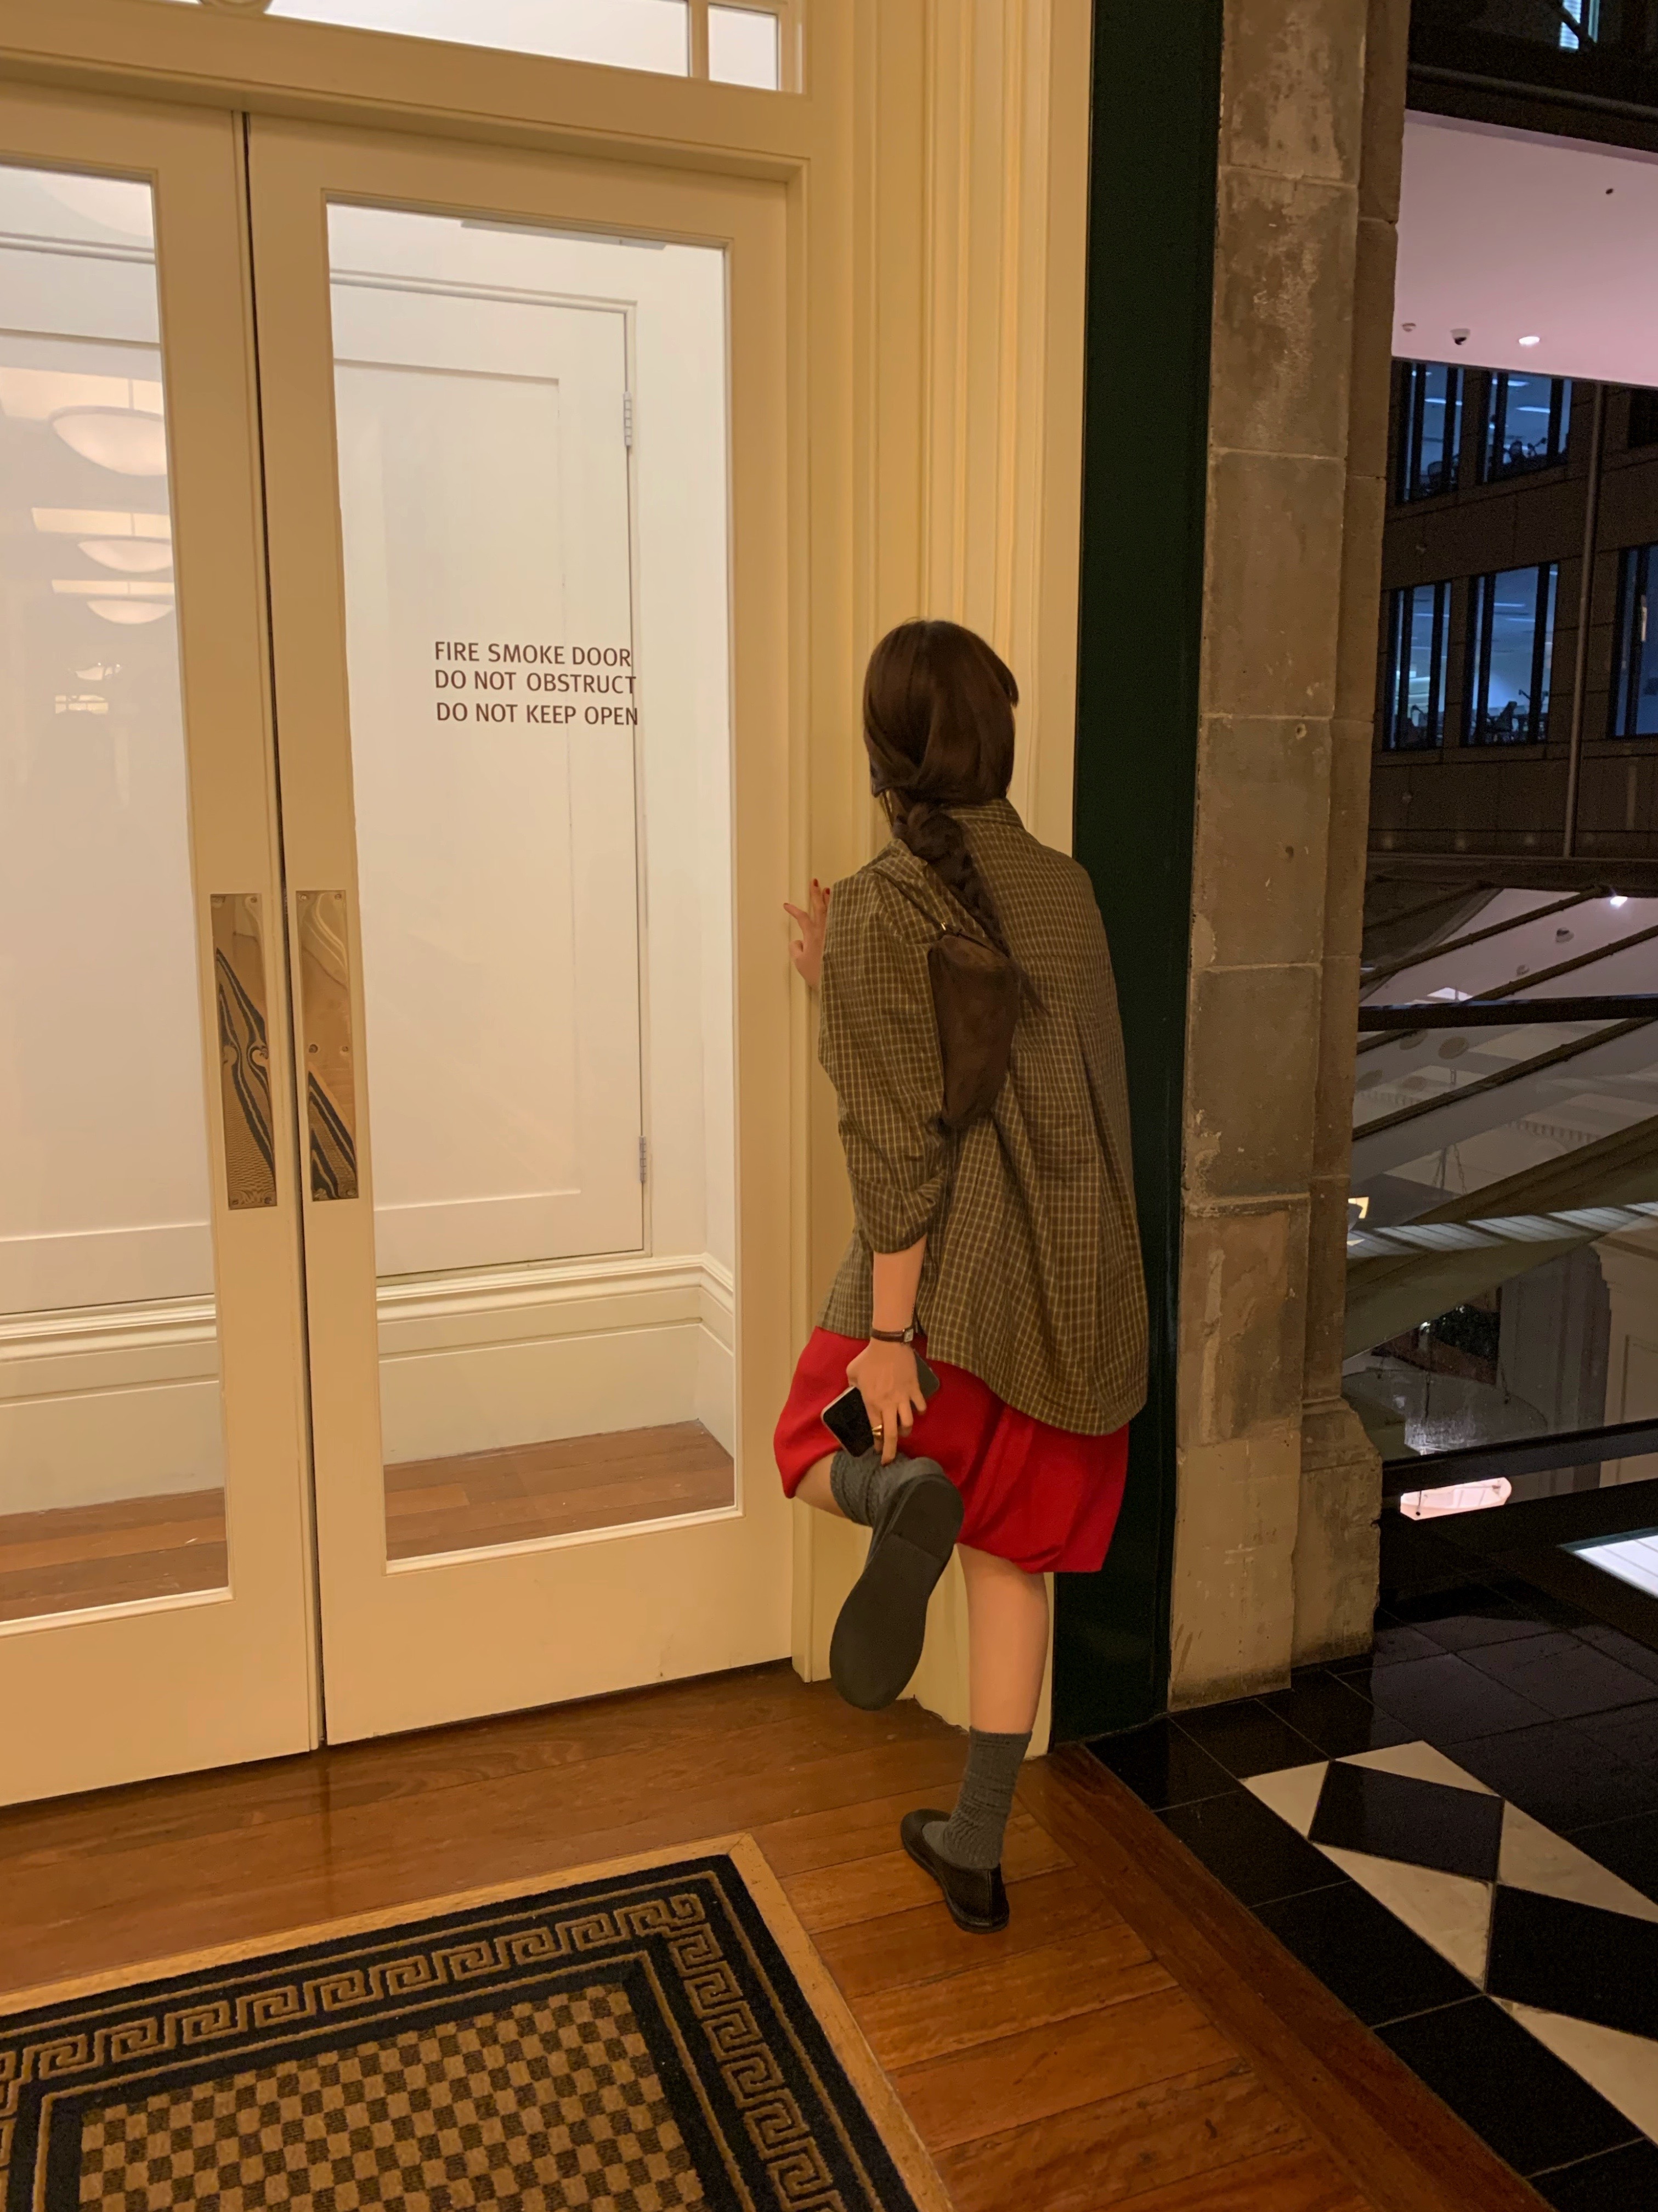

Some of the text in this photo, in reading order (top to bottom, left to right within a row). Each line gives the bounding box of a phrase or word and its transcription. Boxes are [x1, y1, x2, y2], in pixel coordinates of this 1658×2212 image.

[435, 641, 631, 667] FIRE SMOKE DOOR
[435, 669, 636, 694] DO NOT OBSTRUCT
[437, 702, 638, 725] DO NOT KEEP OPEN
